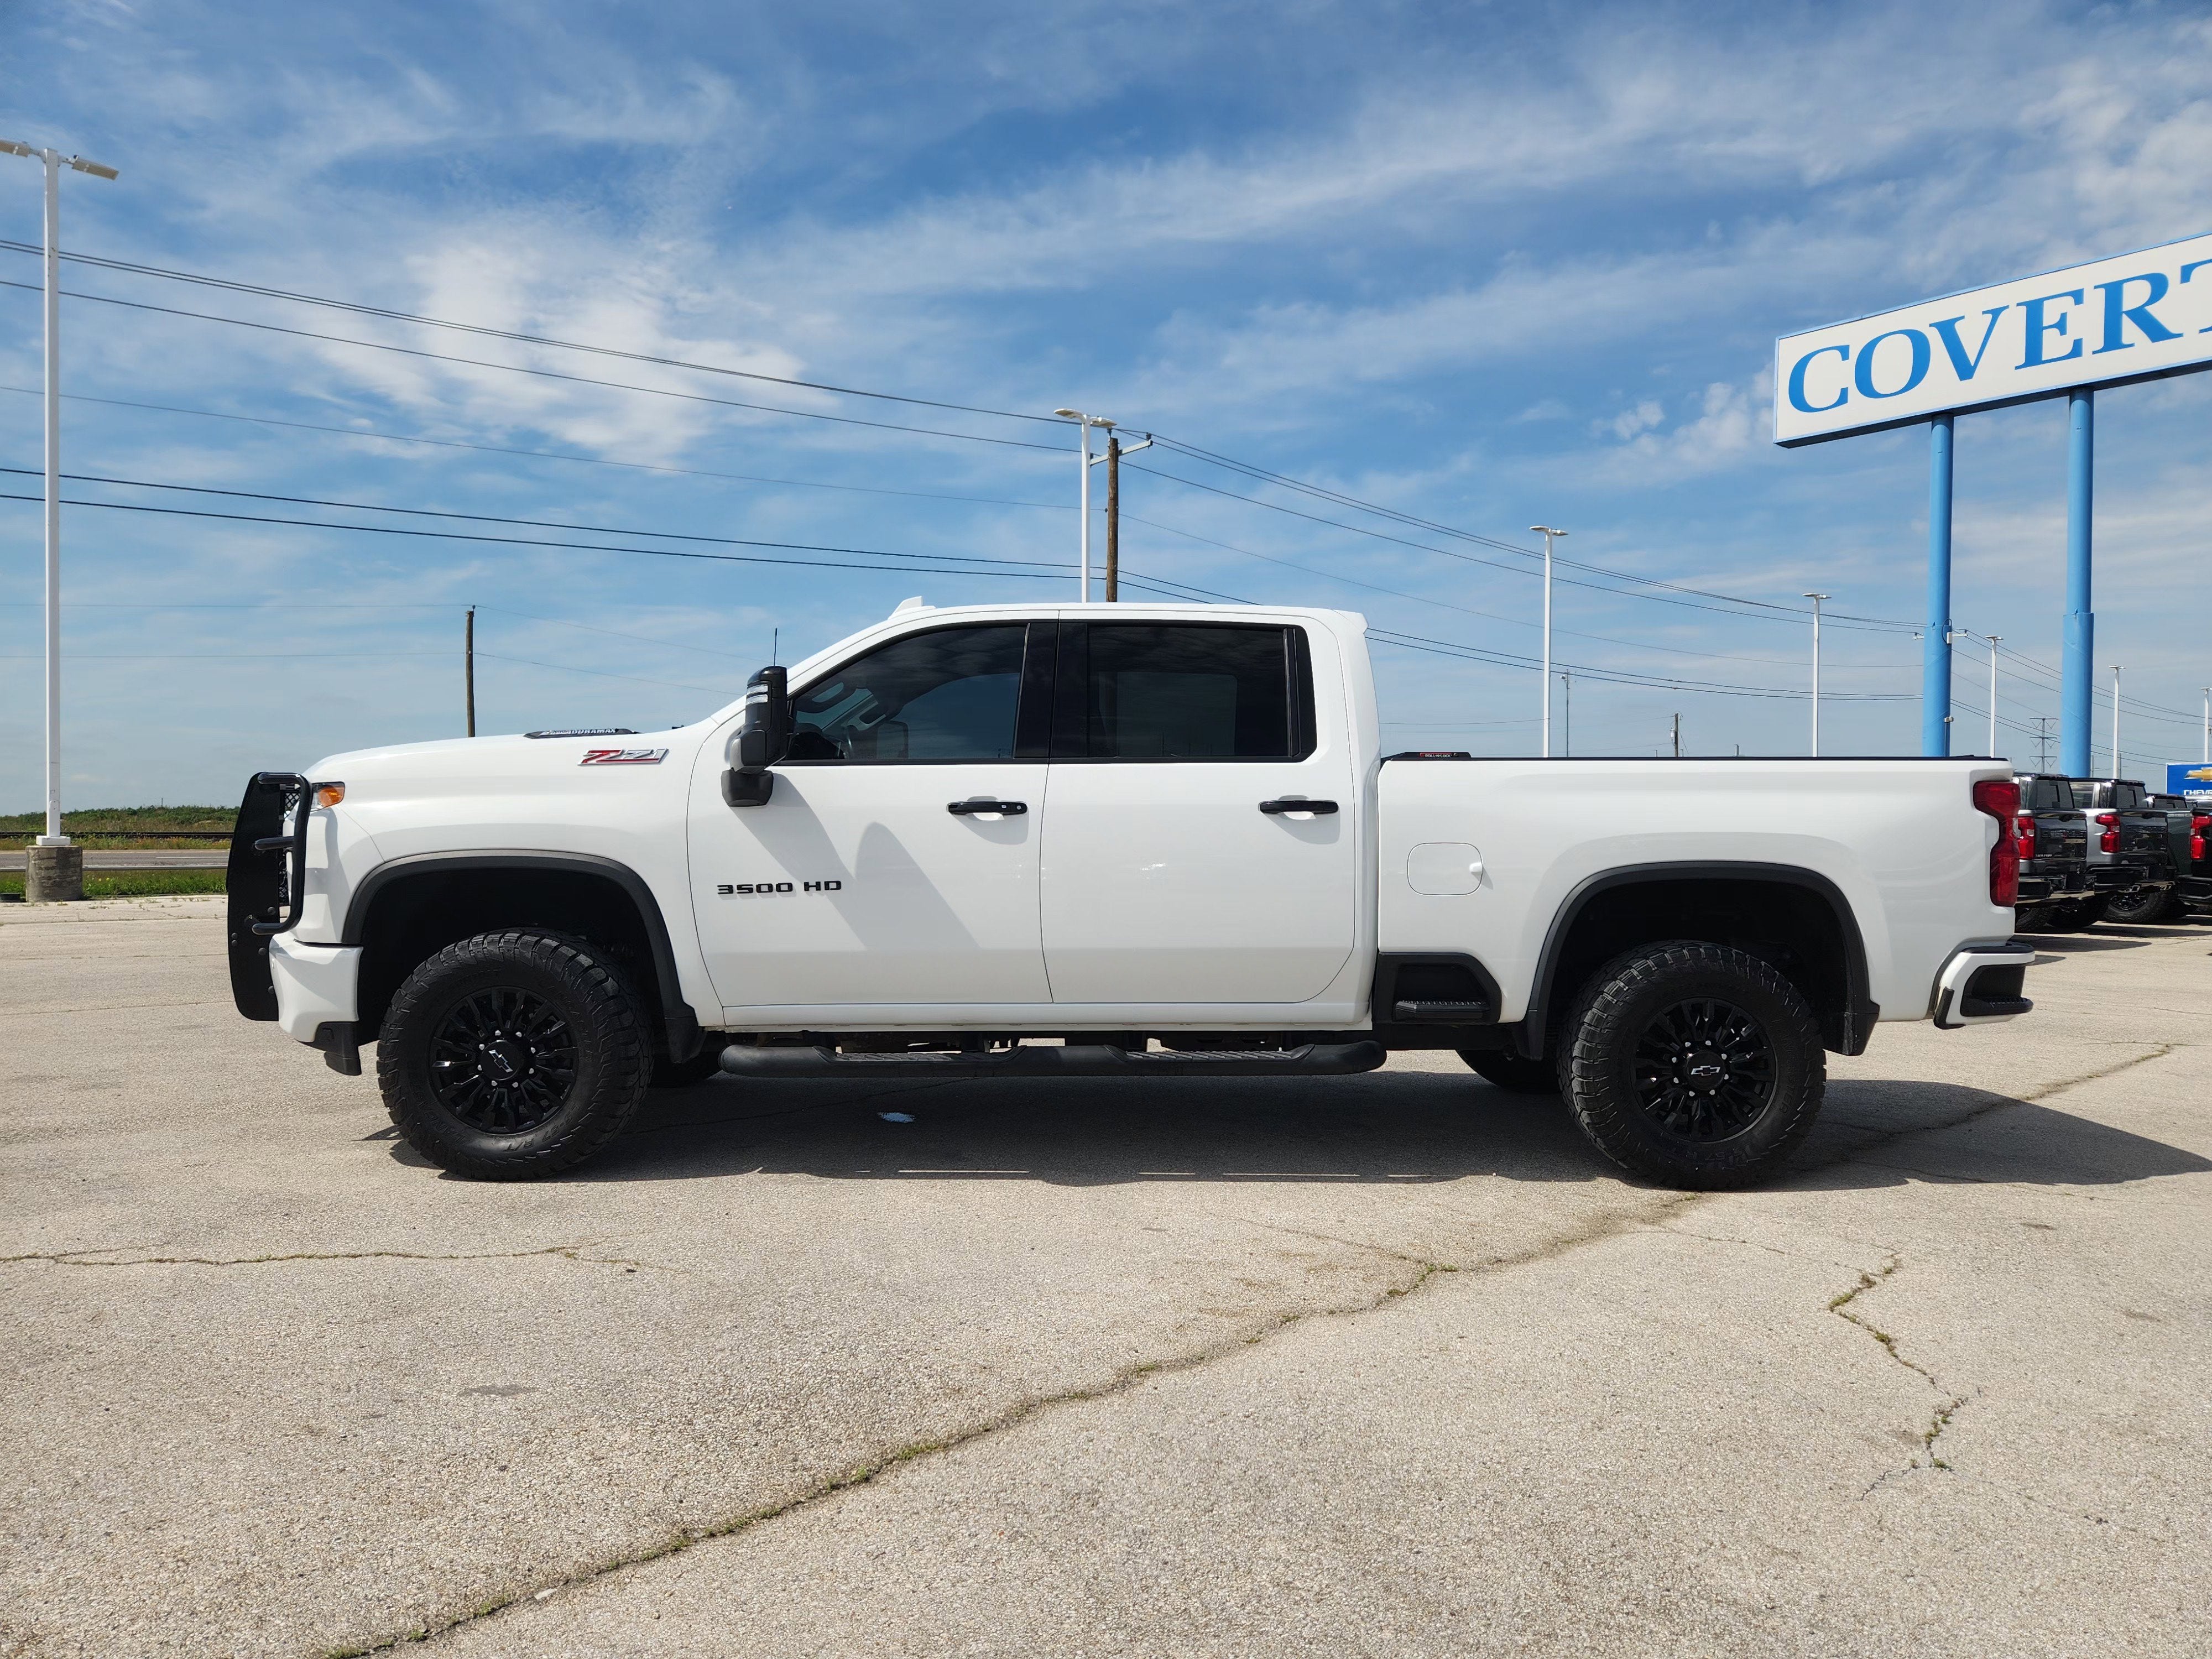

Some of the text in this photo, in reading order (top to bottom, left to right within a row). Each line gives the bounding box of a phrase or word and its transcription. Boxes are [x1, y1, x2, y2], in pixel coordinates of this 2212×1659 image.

[577, 748, 670, 766] Z71
[717, 880, 842, 895] 3500 HD
